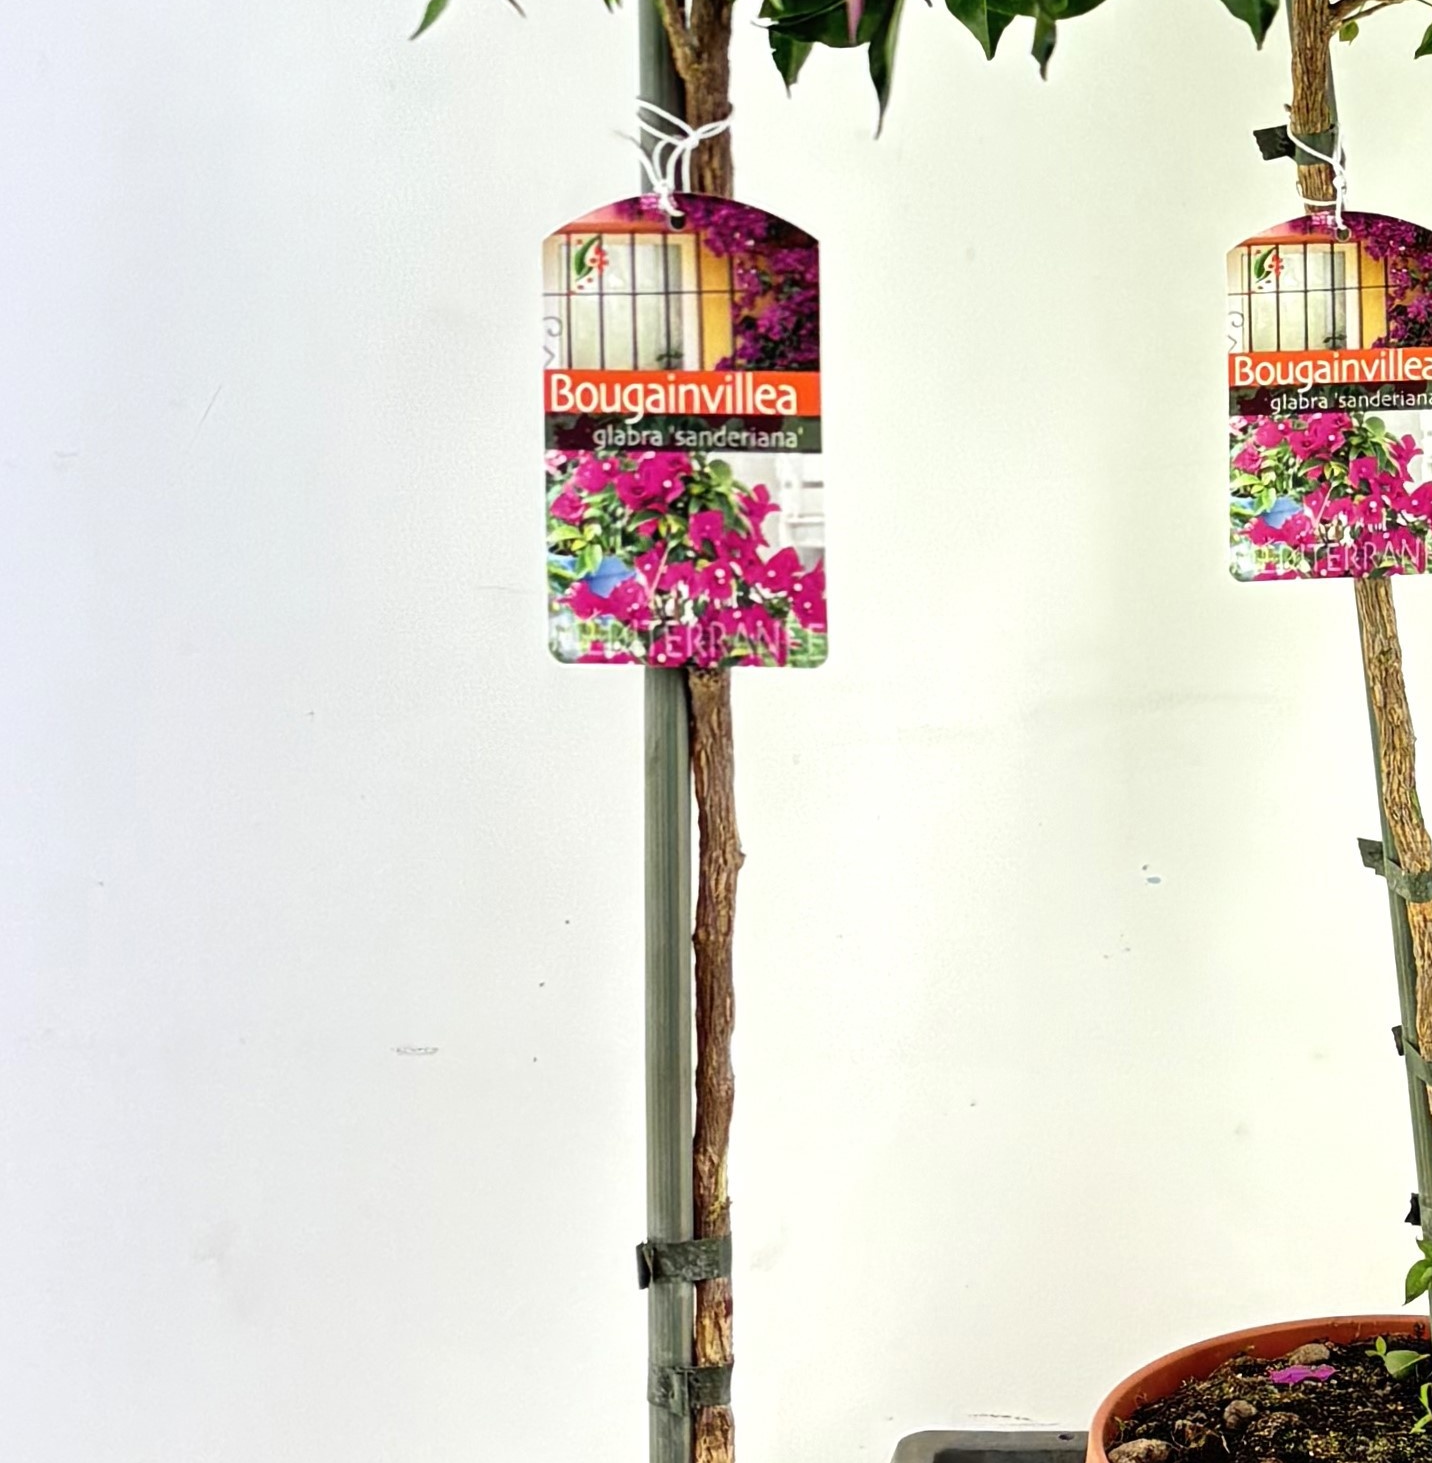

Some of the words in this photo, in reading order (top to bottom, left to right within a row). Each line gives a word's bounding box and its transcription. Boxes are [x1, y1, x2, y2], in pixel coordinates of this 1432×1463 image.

[550, 372, 798, 424] Bougainvillea
[1270, 394, 1329, 415] glabra
[592, 425, 664, 450] glabra
[669, 426, 804, 449] 'sanderiana'
